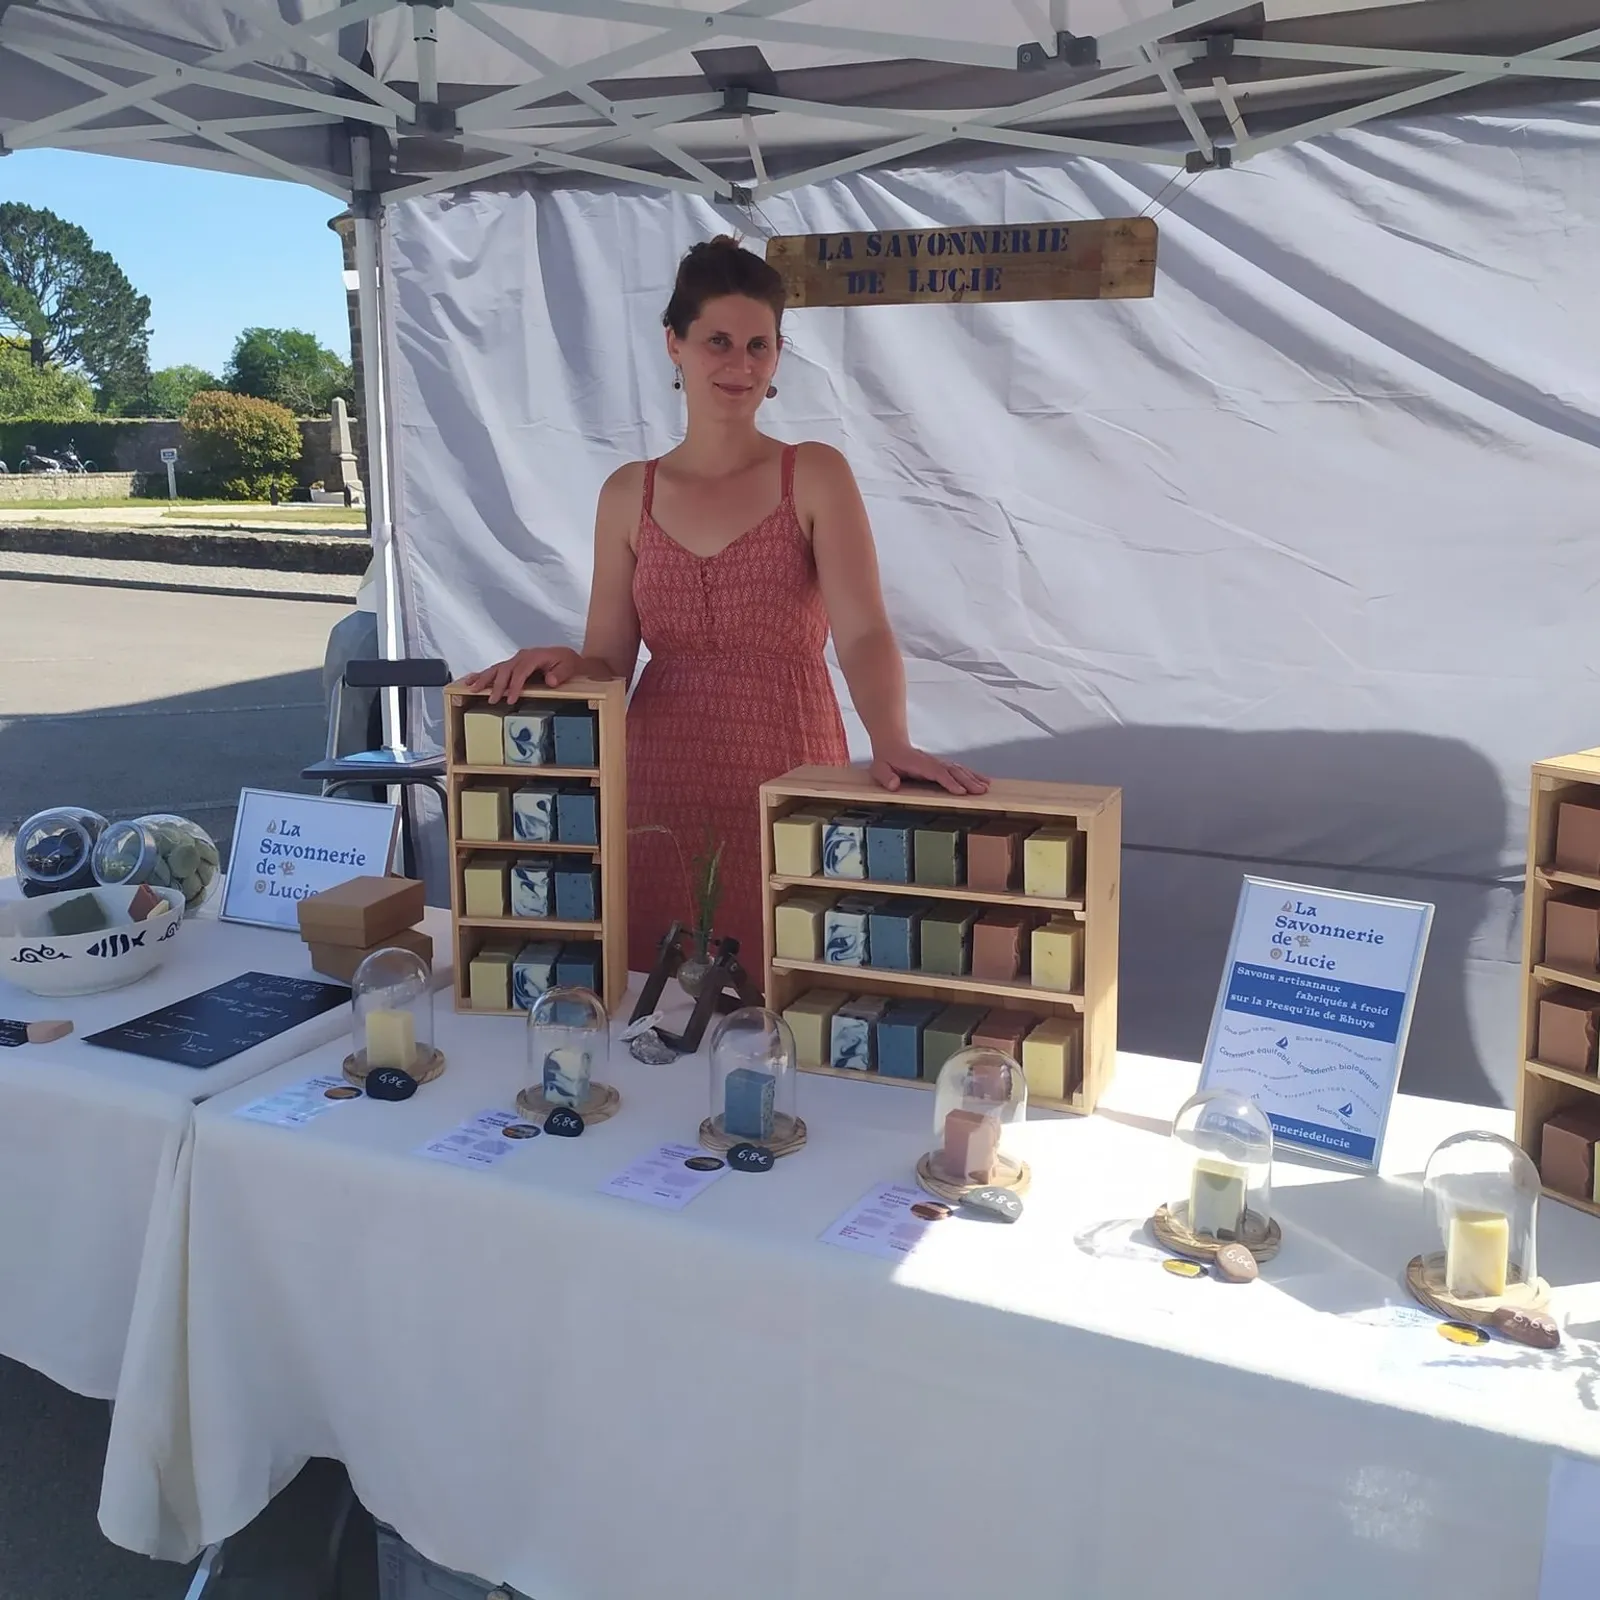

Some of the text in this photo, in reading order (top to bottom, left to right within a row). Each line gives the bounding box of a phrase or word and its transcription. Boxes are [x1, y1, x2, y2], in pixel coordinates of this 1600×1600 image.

[817, 228, 1069, 261] LA SAVONNERIE
[847, 267, 1003, 295] DE LUCIE
[279, 820, 301, 837] La
[259, 838, 366, 867] Savonnerie
[256, 858, 276, 875] de
[1294, 901, 1317, 917] La
[1271, 931, 1292, 946] de
[1274, 915, 1385, 945] Savonnerie
[1284, 949, 1336, 971] Lucie
[1236, 966, 1341, 994] Savons artisanaux
[1230, 993, 1250, 1004] sur
[1251, 996, 1263, 1007] la
[1323, 1010, 1336, 1021] de
[1339, 1013, 1376, 1030] Rhuys
[1295, 990, 1389, 1017] fabriqués à froid
[1219, 1046, 1292, 1066] Commerce équitable
[1338, 1063, 1380, 1090] biologiques
[552, 1113, 579, 1129] 6,8€
[1272, 1122, 1351, 1149] nneriedelucie
[737, 1149, 768, 1165] 6,8€
[981, 1191, 1018, 1211] 6,8€
